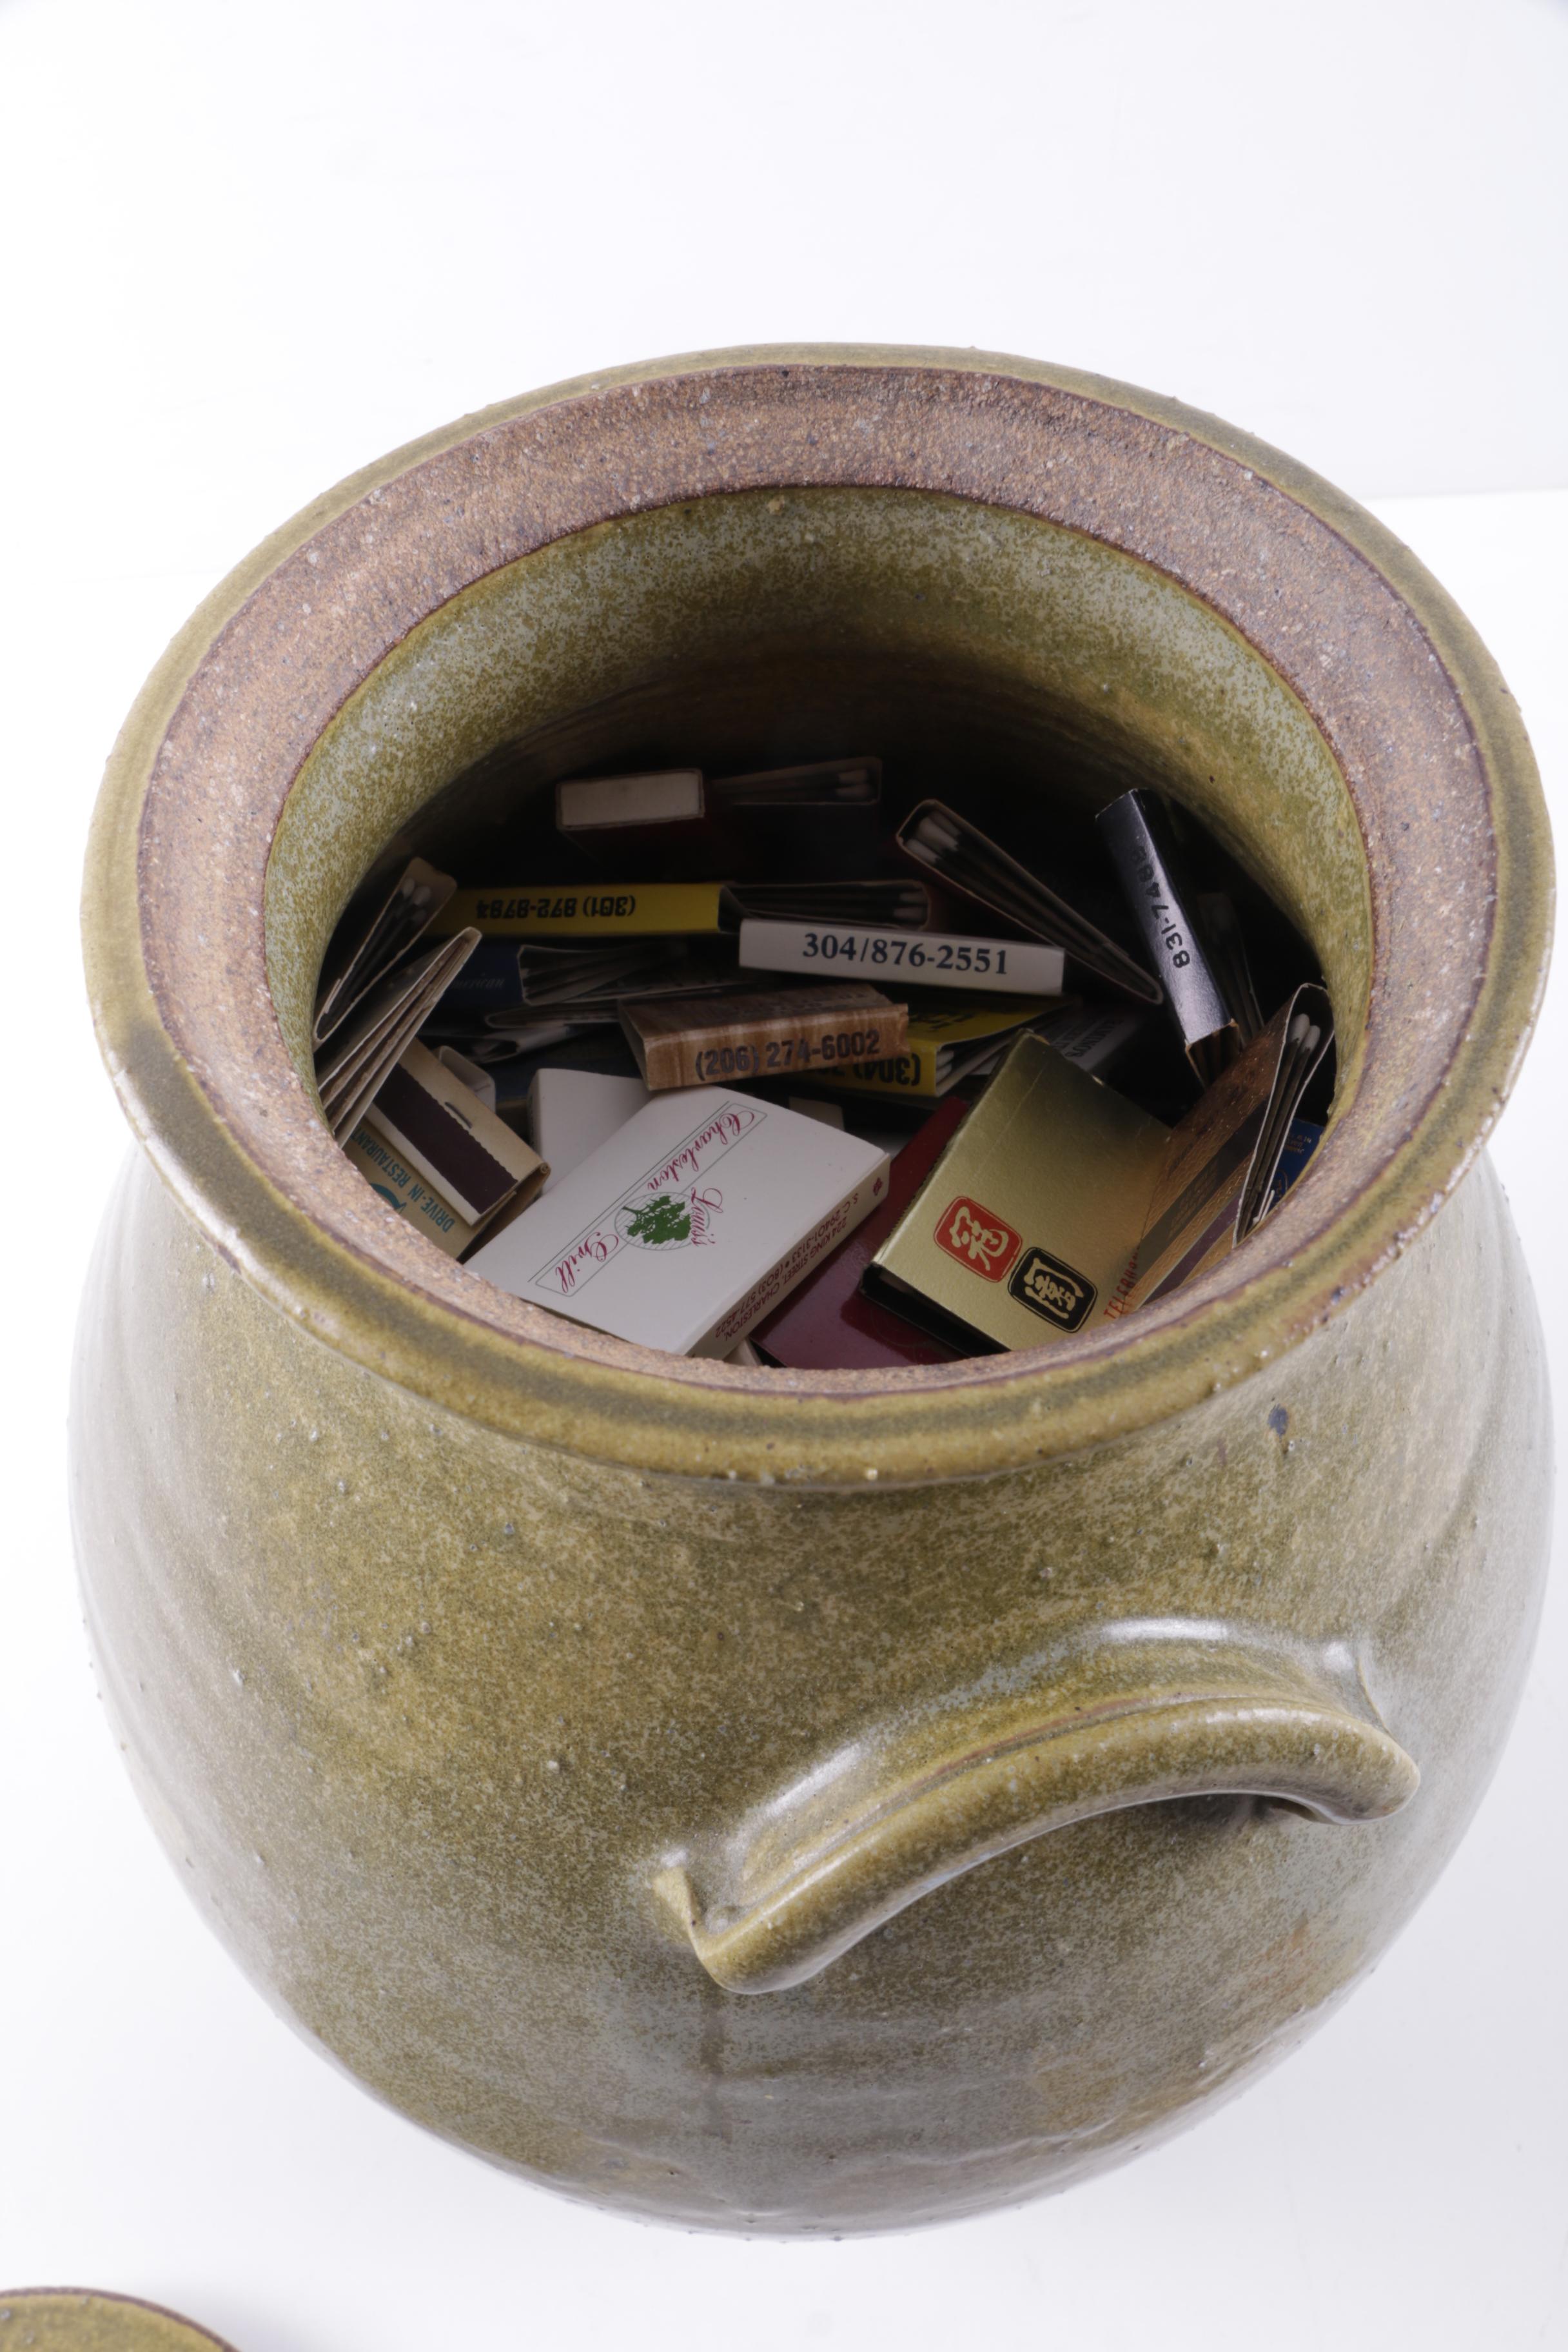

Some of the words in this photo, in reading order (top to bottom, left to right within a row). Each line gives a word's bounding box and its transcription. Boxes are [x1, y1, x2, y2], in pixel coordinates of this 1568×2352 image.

[582, 896, 636, 917] (301)
[802, 932, 1008, 975] 304/876-2551
[695, 1046, 760, 1082] (206)
[765, 1029, 881, 1069] 274-6002
[647, 1110, 755, 1191] Charleston
[791, 1210, 841, 1264] 29401-3133
[809, 1235, 832, 1259] KING
[830, 1216, 848, 1235] 224
[554, 1231, 620, 1293] Grill
[758, 1263, 784, 1296] (803)
[714, 1291, 757, 1338] 577-4522
